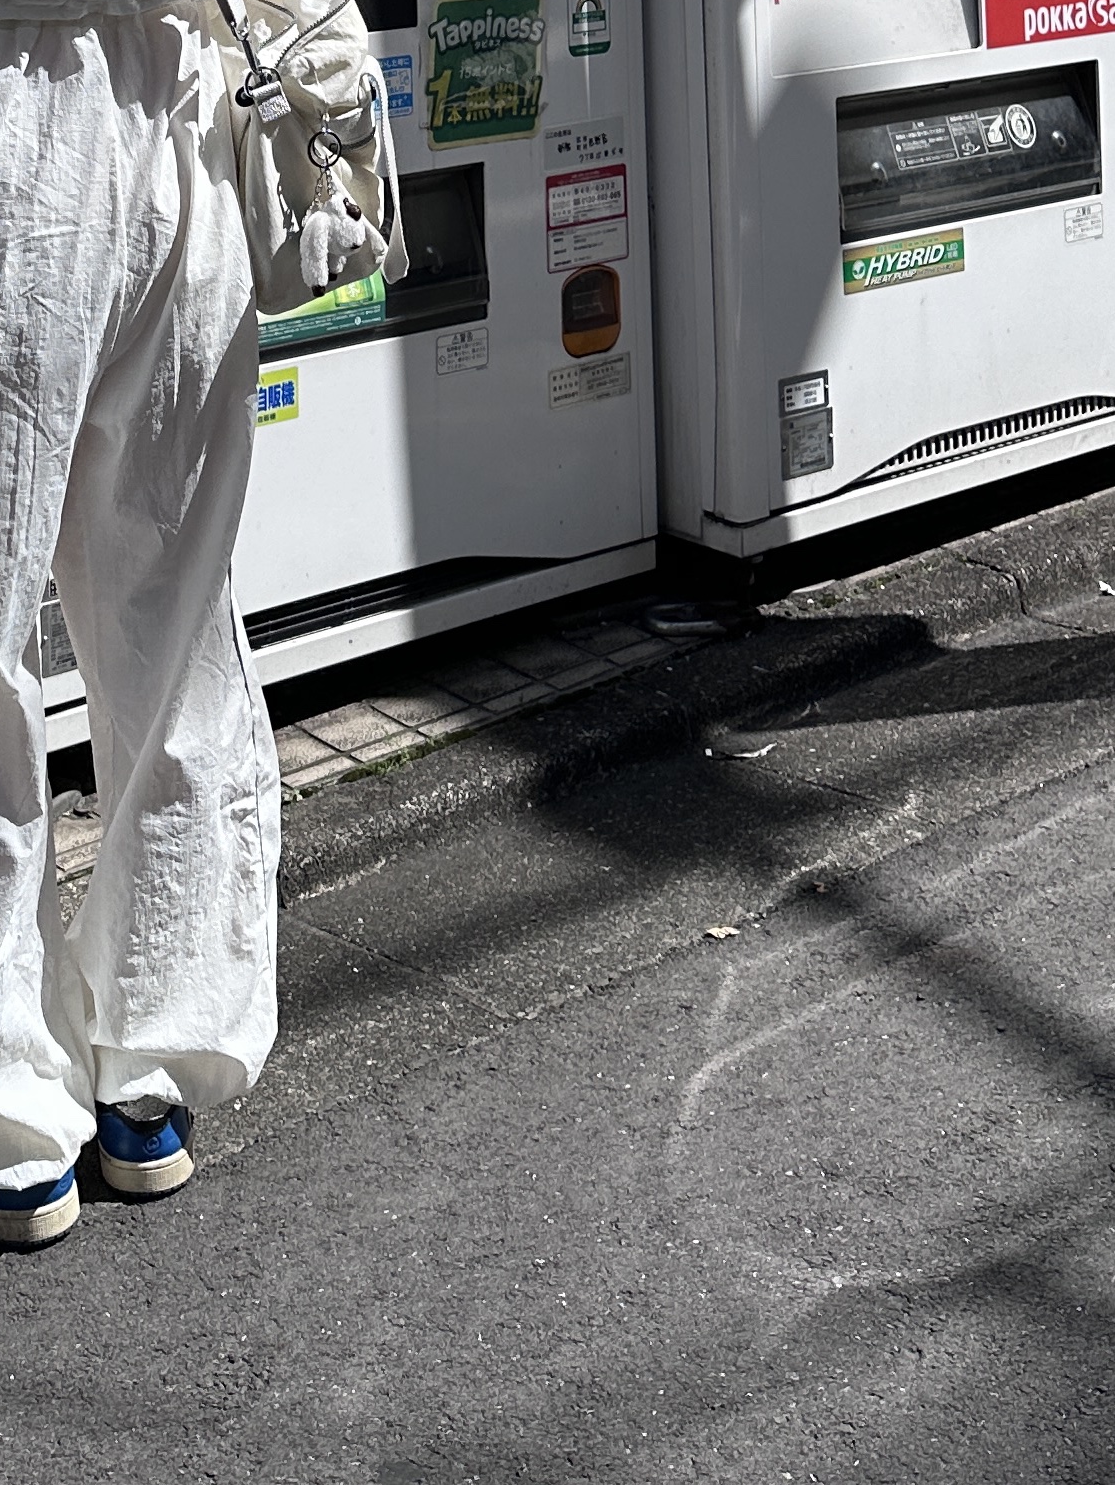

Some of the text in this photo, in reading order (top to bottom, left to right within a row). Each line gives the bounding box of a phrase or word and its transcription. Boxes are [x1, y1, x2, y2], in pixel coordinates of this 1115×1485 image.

[429, 7, 545, 52] Tappiness
[865, 245, 945, 290] HYBRID
[258, 381, 295, 412] 自販機
